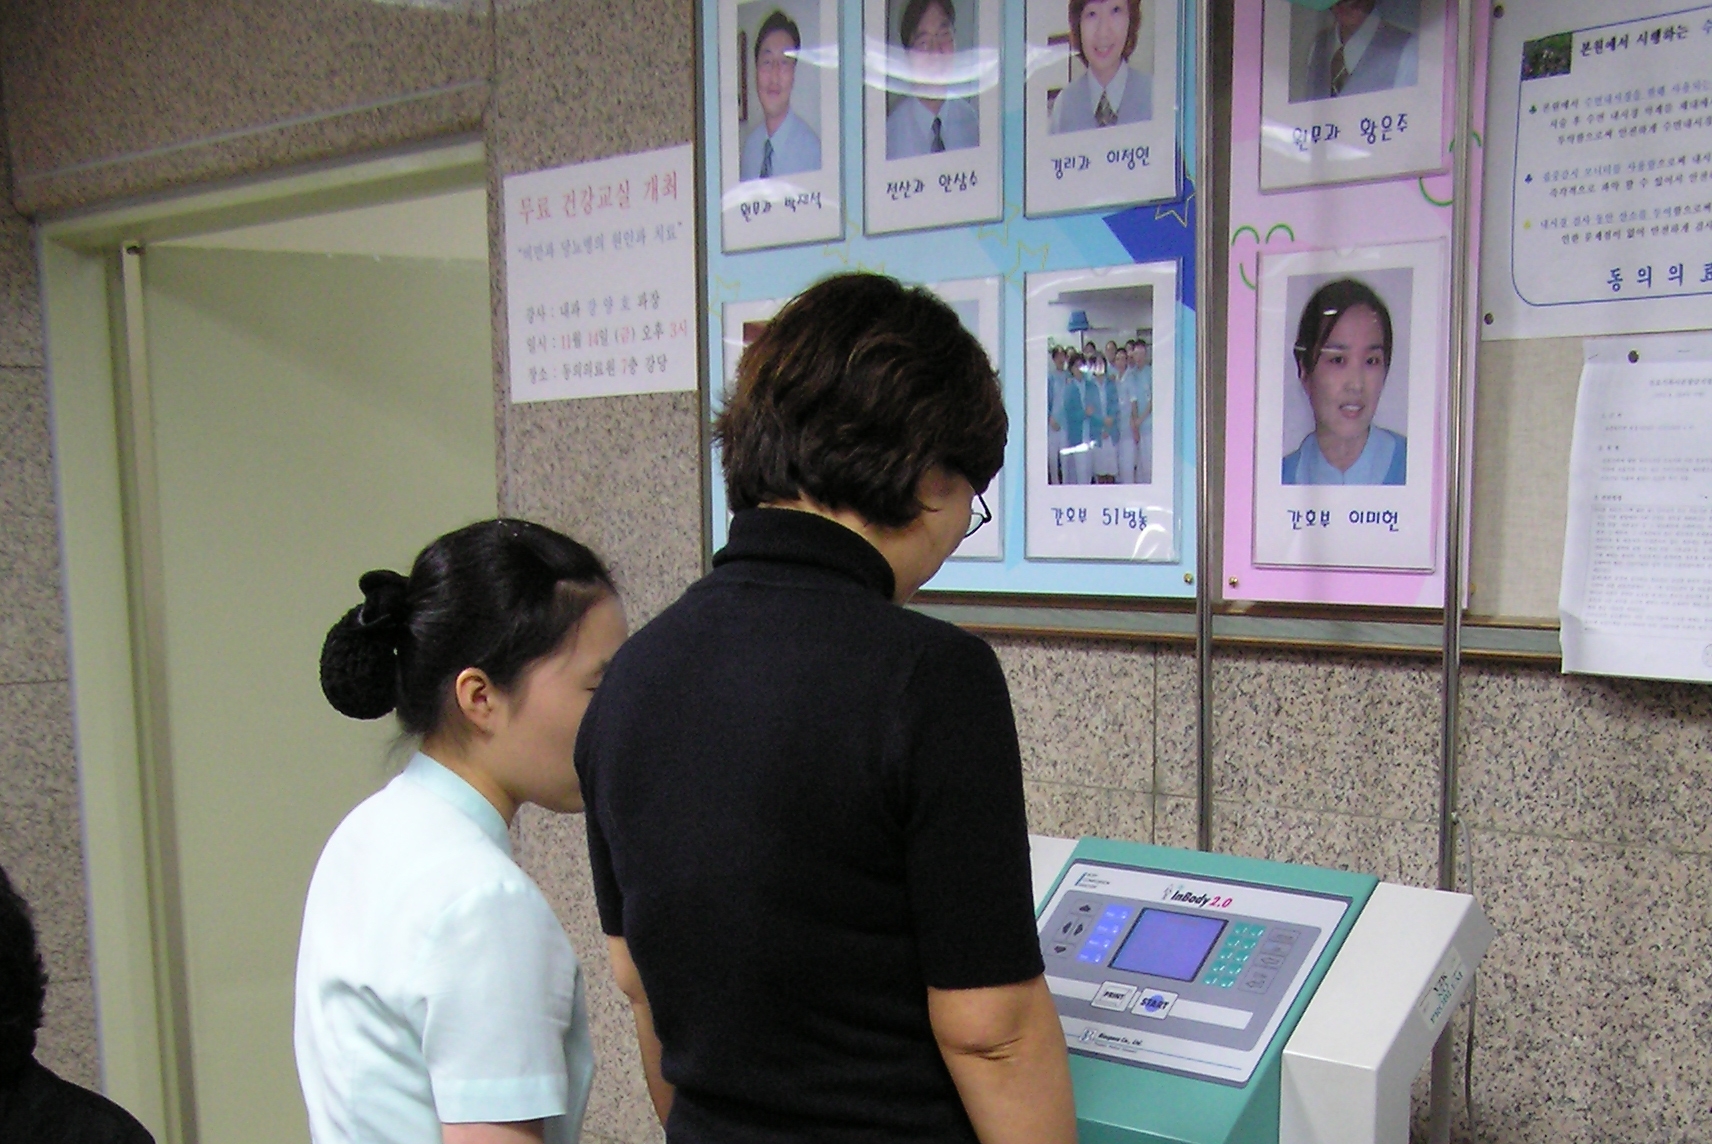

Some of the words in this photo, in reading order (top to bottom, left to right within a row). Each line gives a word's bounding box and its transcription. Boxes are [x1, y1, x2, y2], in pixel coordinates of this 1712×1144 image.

[1581, 33, 1629, 57] 본원에서
[1636, 24, 1688, 46] 시행하는
[1292, 124, 1341, 151] 원무과
[1051, 155, 1091, 180] 경리과
[520, 197, 551, 225] 무료
[563, 179, 631, 218] 건강교실
[644, 170, 677, 204] 개최
[642, 321, 664, 341] 오후
[563, 358, 615, 381] 동의의료원
[645, 353, 668, 374] 강당
[1051, 507, 1087, 526] 간호부
[1287, 509, 1330, 530] 간호부
[1171, 890, 1211, 909] InBody
[1209, 895, 1233, 909] 2.0
[1140, 997, 1170, 1010] START
